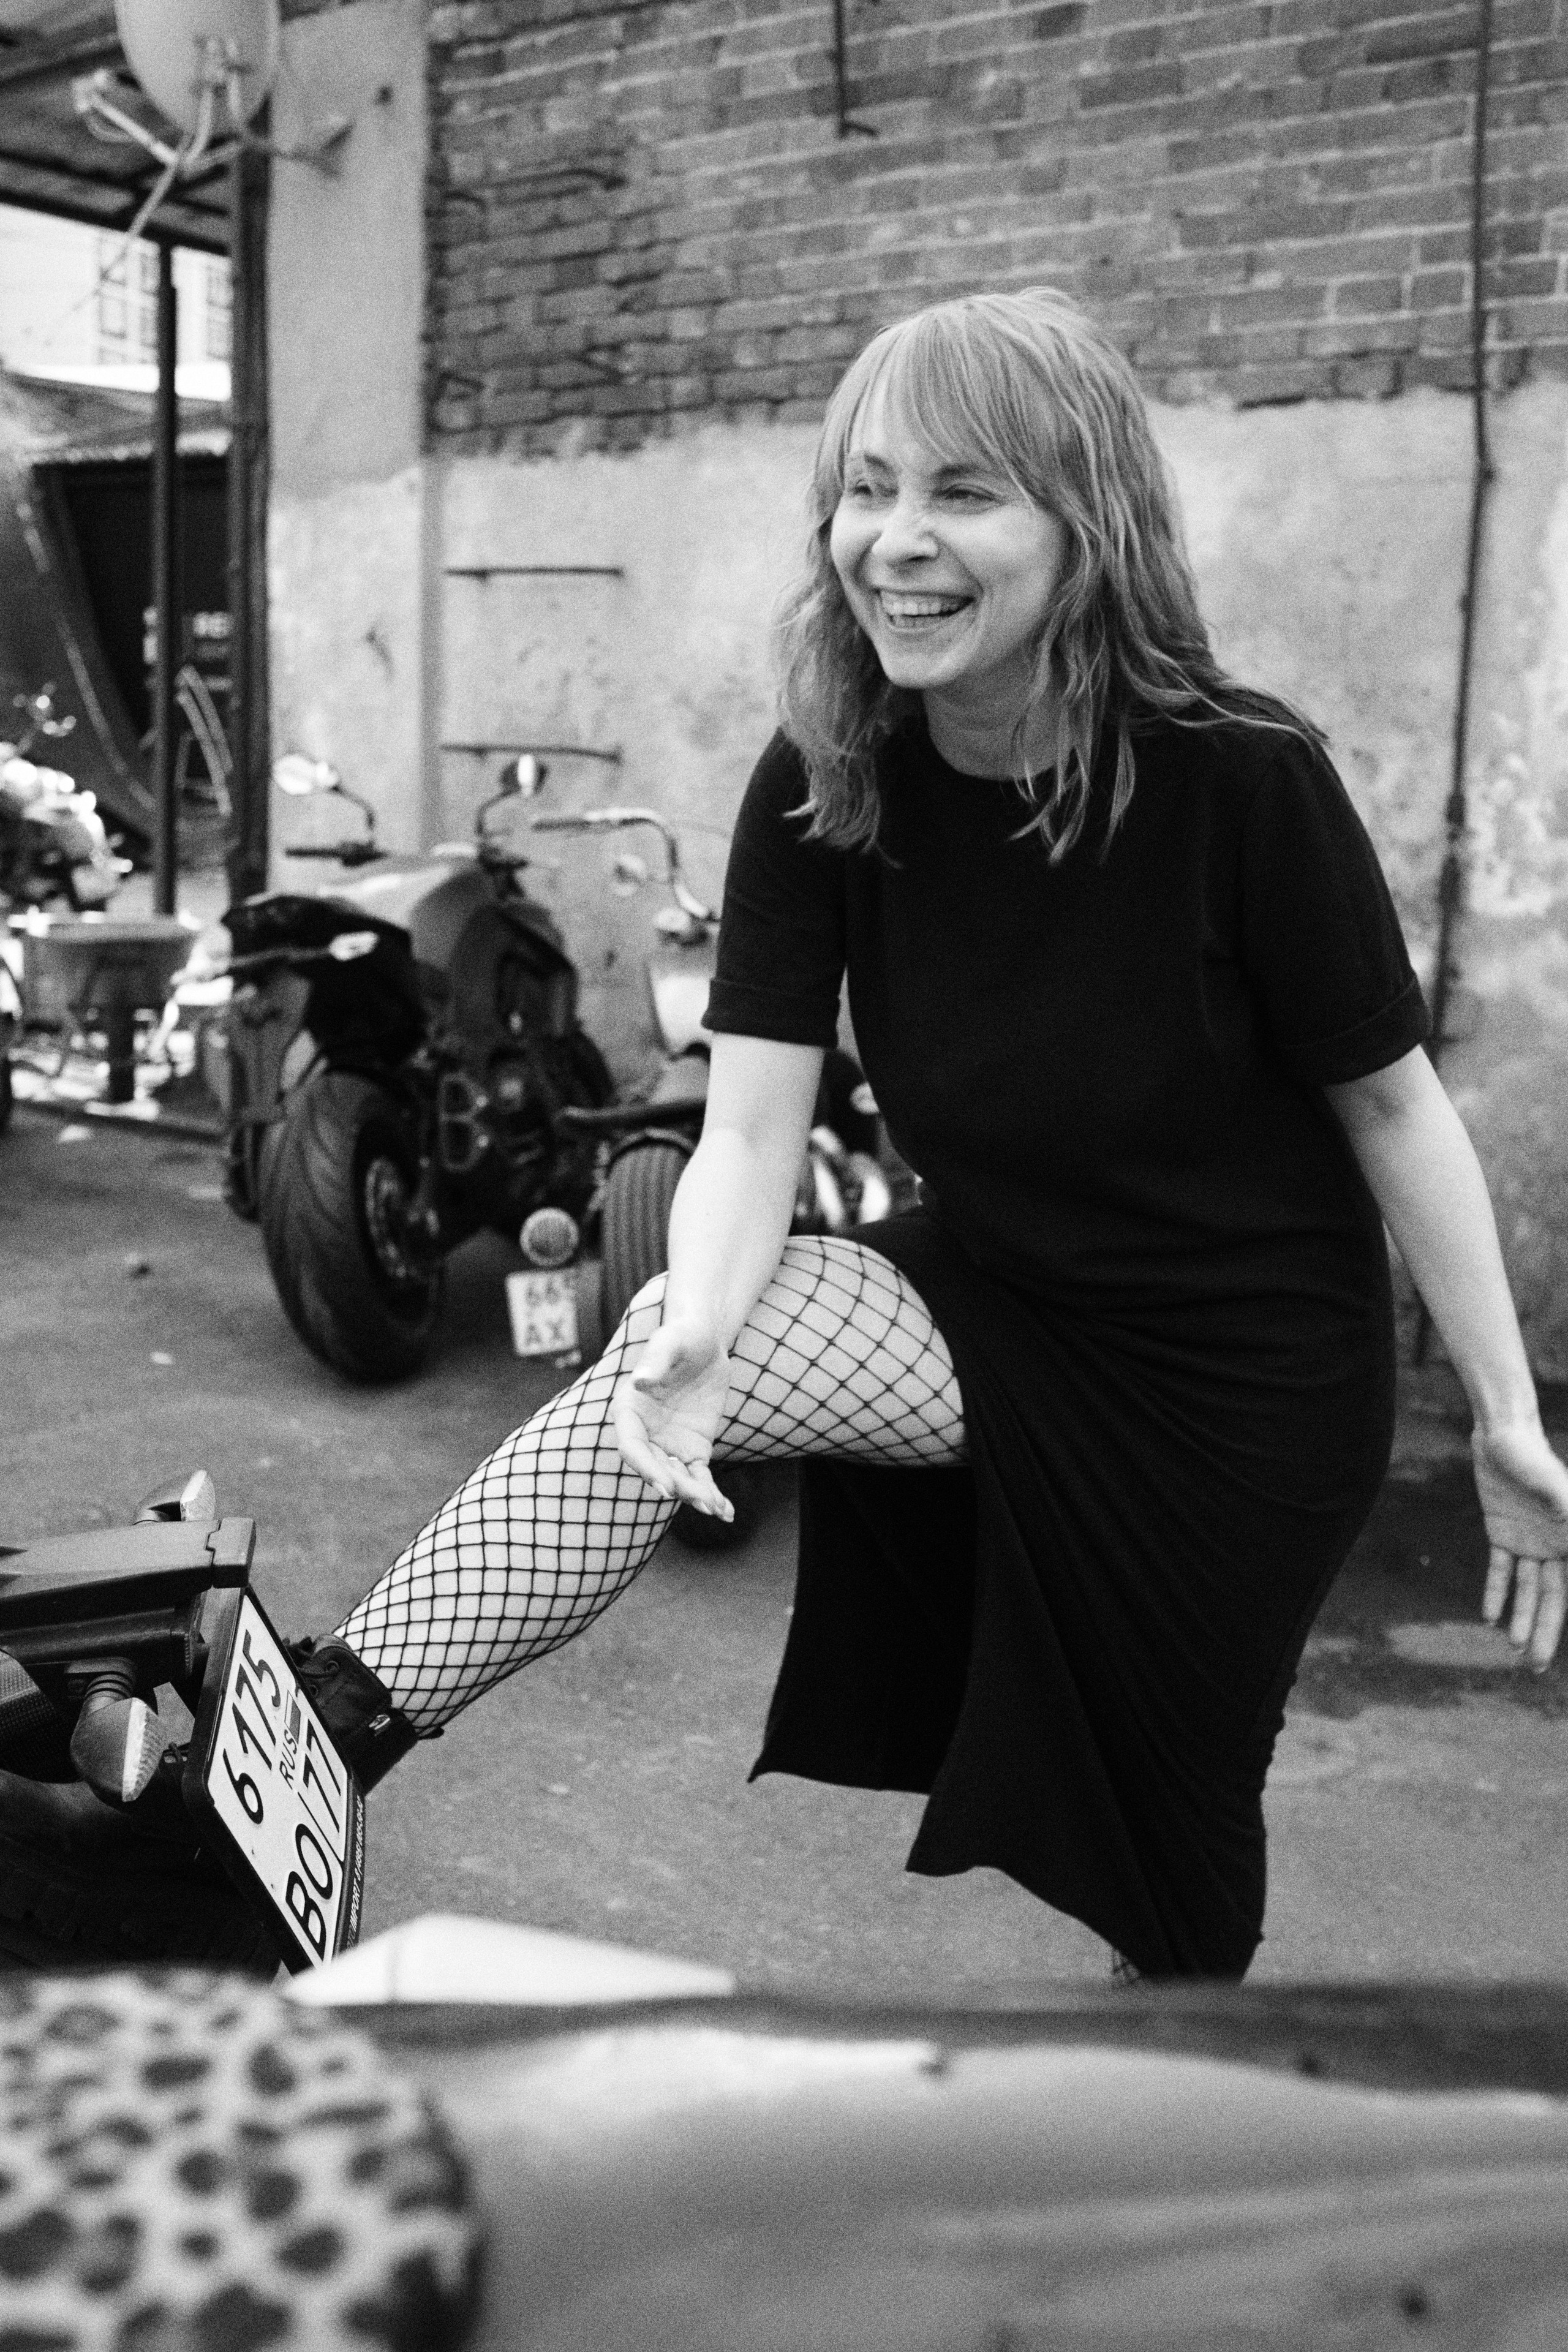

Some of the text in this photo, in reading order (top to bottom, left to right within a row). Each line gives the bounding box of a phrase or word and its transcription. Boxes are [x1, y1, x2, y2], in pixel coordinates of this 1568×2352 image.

[223, 1629, 281, 1825] 6175
[279, 1729, 298, 1790] RUS
[285, 1718, 341, 1962] BO 77
